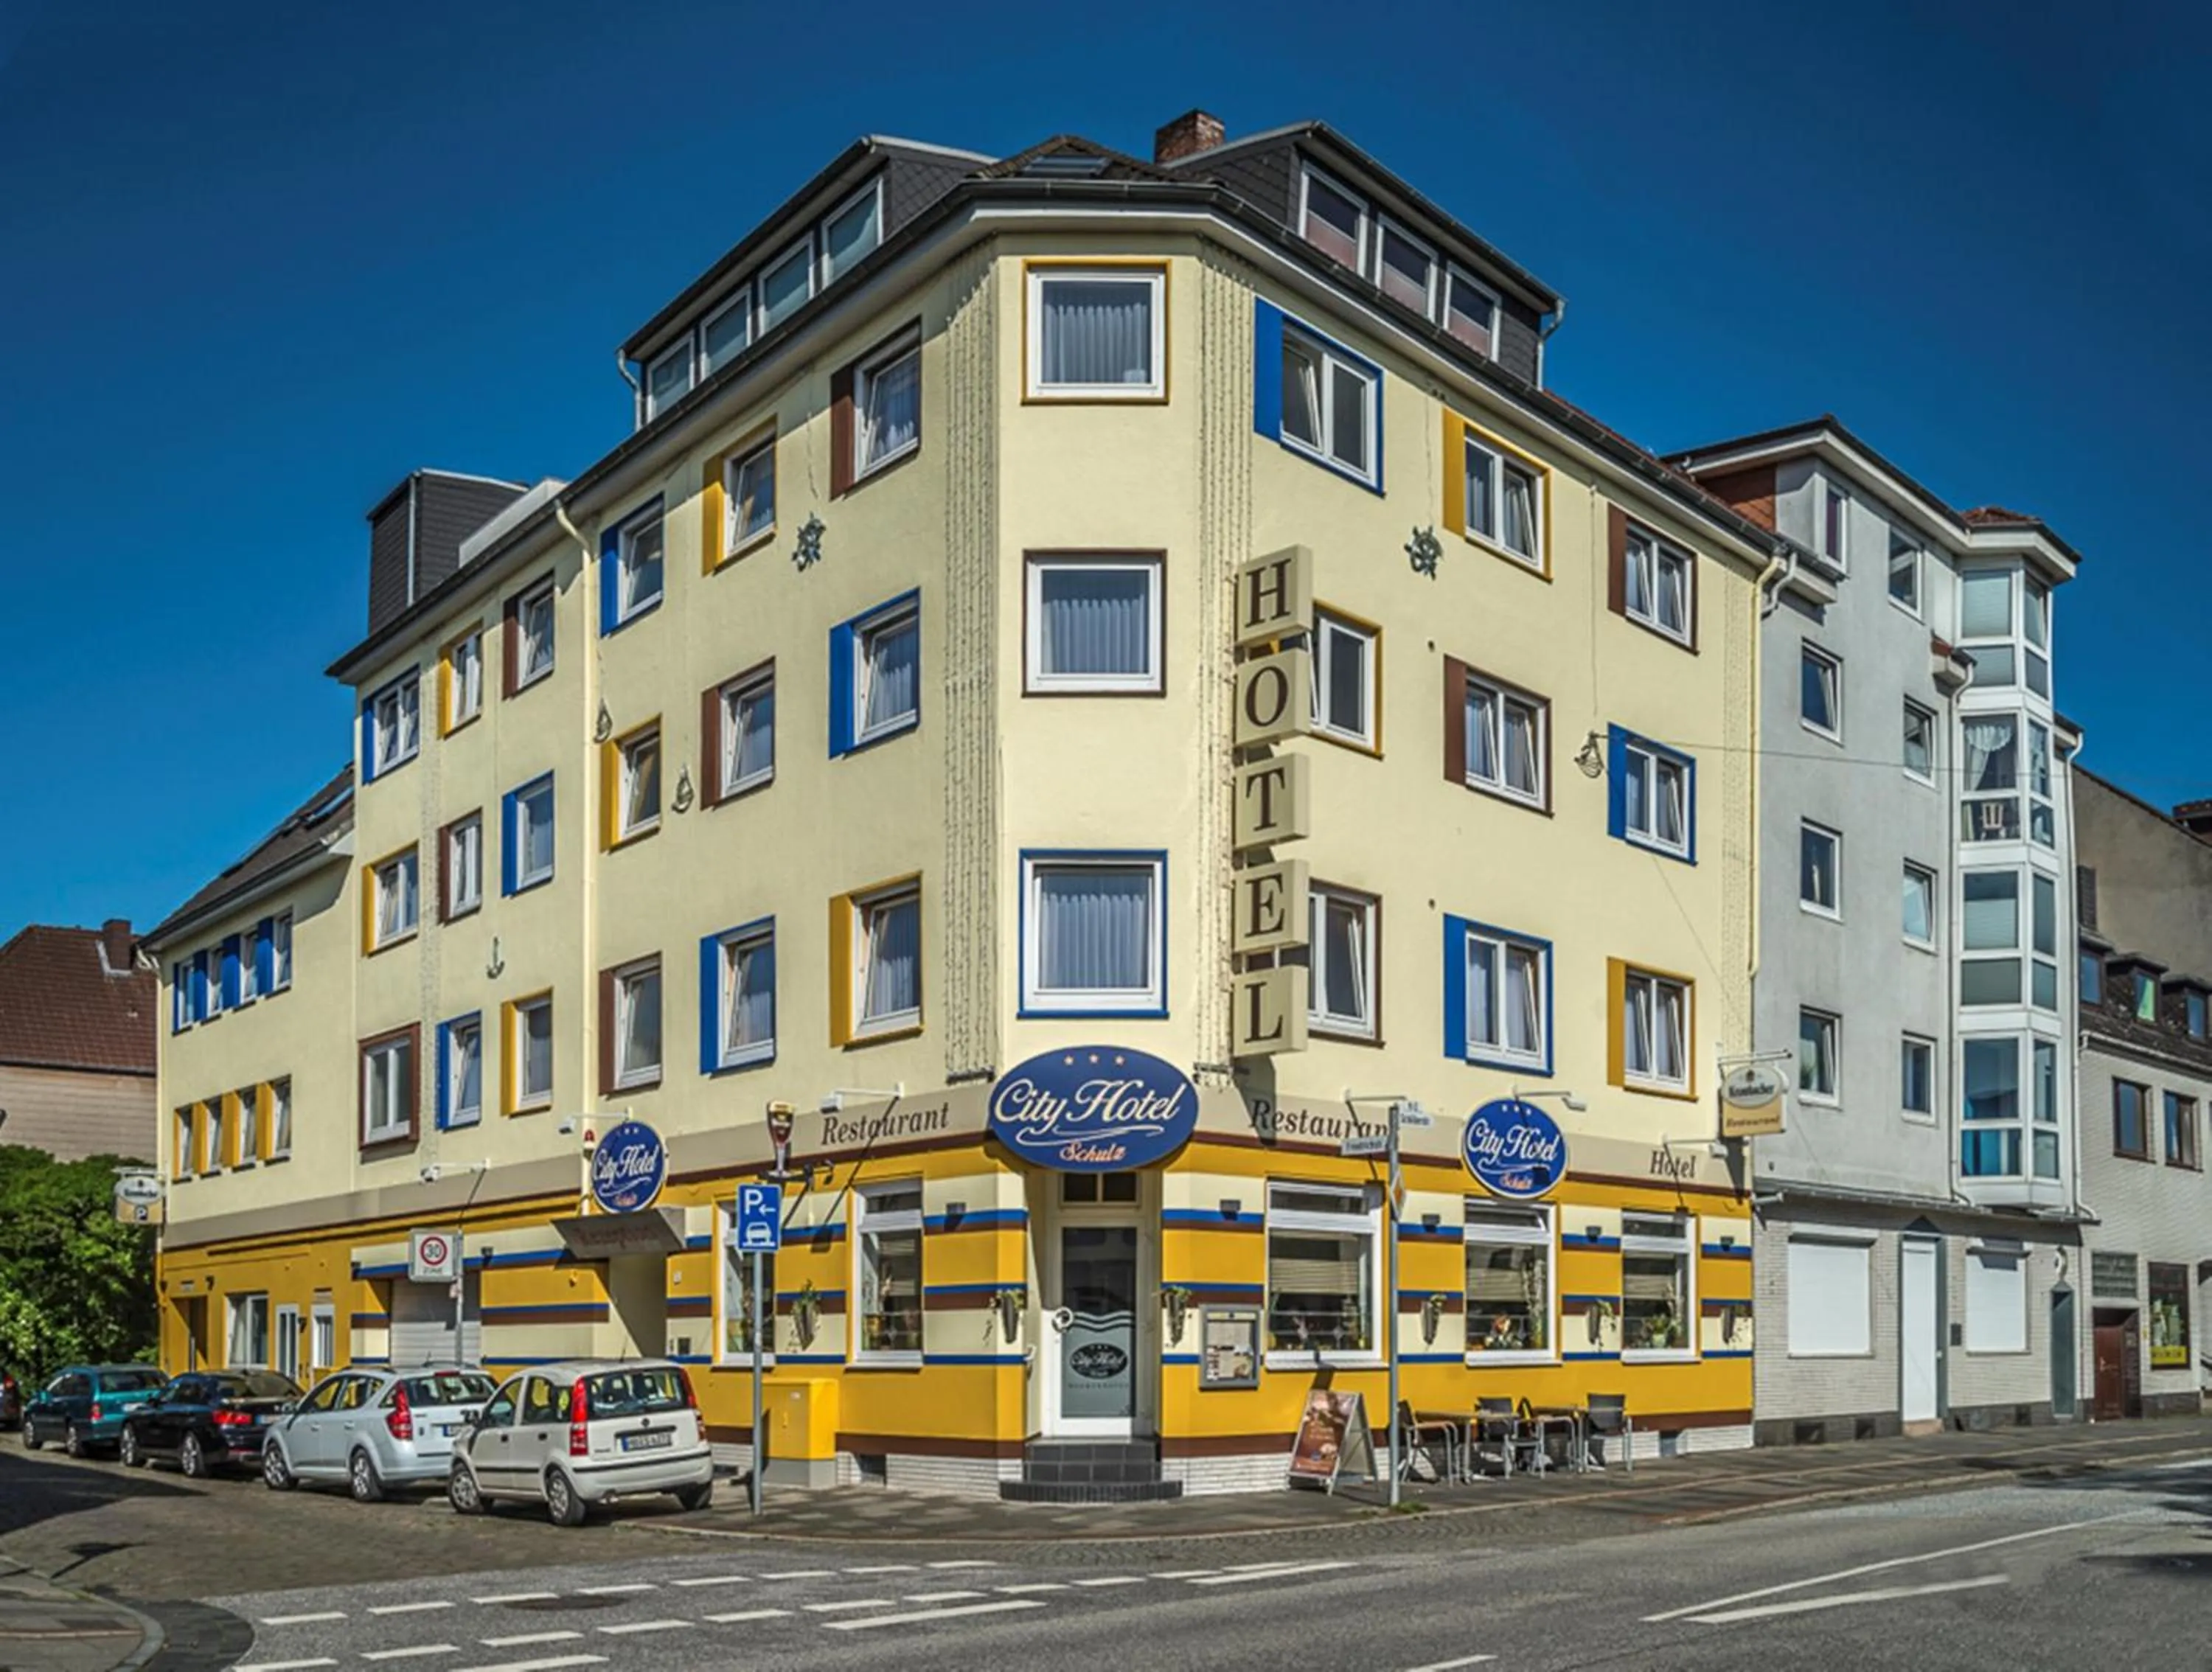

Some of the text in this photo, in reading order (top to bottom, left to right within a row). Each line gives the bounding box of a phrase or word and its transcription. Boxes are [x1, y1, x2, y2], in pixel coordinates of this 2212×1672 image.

[1245, 557, 1291, 1044] HOTEL
[821, 1101, 950, 1146] Restaurant
[994, 1078, 1187, 1134] City Hotel
[1248, 1098, 1389, 1139] Restauran
[1060, 1140, 1127, 1162] Schulz
[1467, 1118, 1560, 1164] City Hotel
[1650, 1150, 1697, 1178] Hotel
[745, 1188, 763, 1215] P
[425, 1244, 442, 1258] 30
